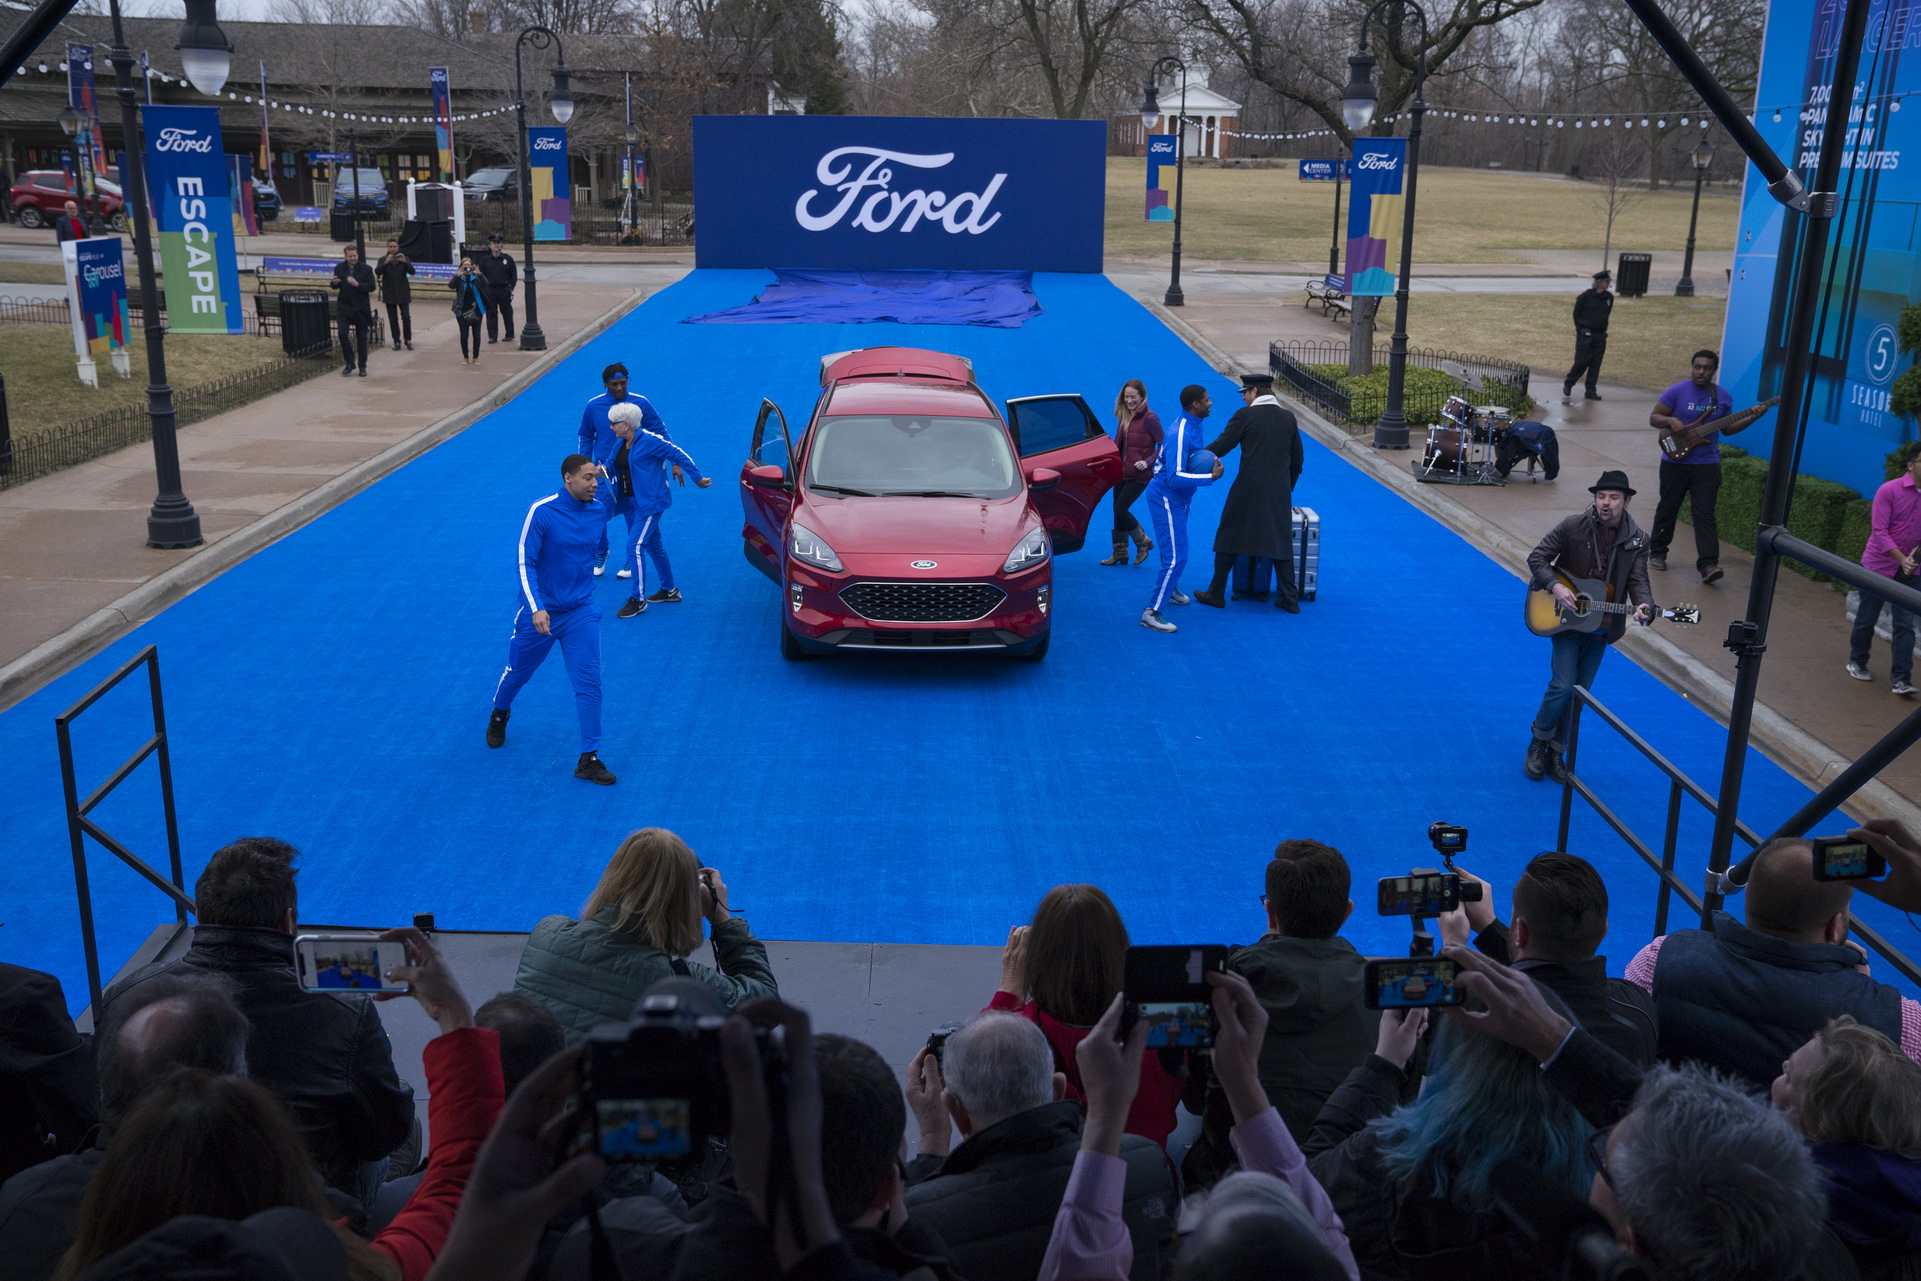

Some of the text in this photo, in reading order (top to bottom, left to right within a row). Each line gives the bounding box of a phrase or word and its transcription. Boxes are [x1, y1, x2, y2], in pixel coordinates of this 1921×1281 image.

[1815, 6, 1921, 60] LGER
[431, 70, 447, 82] Ford
[1809, 84, 1833, 105] 7,00
[1805, 104, 1877, 126] PANMC
[155, 127, 212, 153] Ford
[534, 137, 562, 151] Ford
[1150, 141, 1174, 153] Ford
[1802, 127, 1859, 148] SKYHT
[1357, 152, 1398, 170] Ford
[1798, 150, 1900, 169] PREM SUITES
[795, 146, 1008, 235] Ford
[176, 176, 218, 314] ESCAPE
[83, 259, 122, 282] Carousel
[1873, 336, 1891, 371] 5
[1851, 384, 1894, 413] SEASO
[1860, 408, 1883, 428] HOTEL
